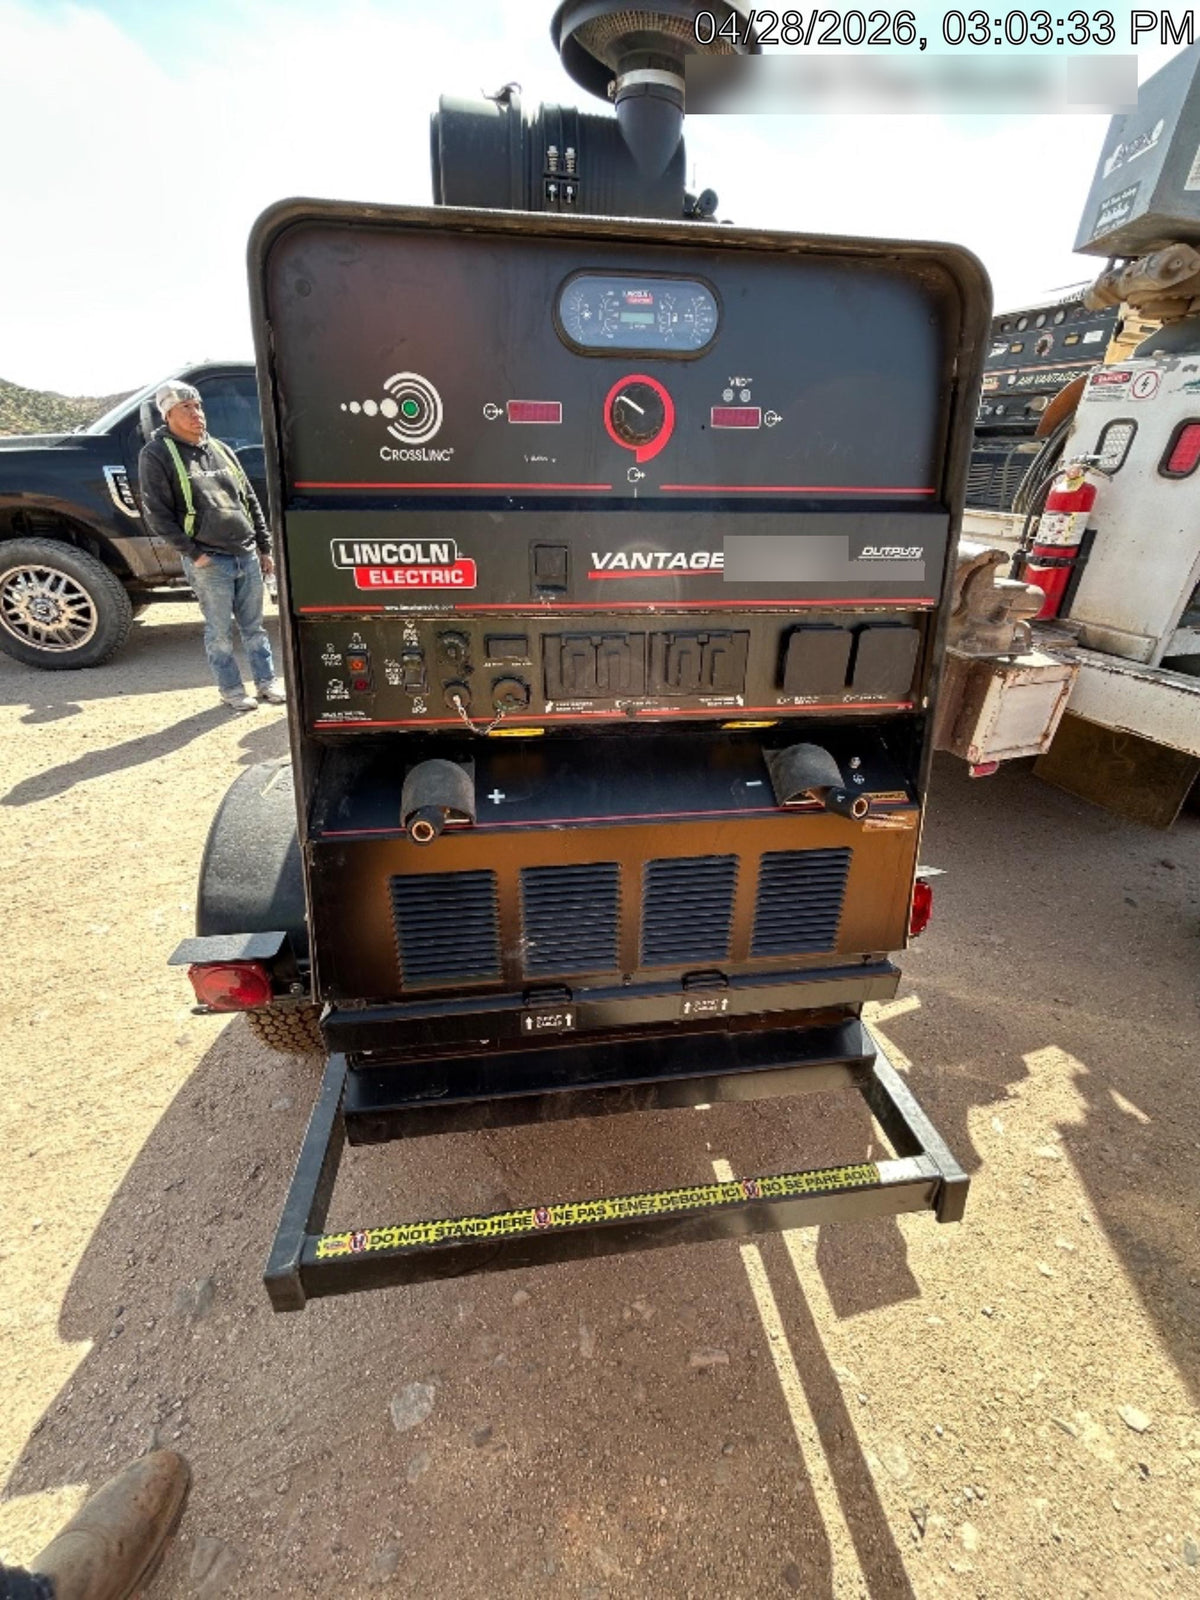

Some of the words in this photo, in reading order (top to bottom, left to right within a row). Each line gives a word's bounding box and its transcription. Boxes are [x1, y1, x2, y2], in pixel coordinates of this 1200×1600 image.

[338, 543, 449, 565] LINCOLN
[591, 552, 725, 570] VANTAGE
[369, 569, 465, 584] ELECTRIC
[761, 1182, 783, 1193] NO
[786, 1180, 804, 1190] SE
[806, 1174, 841, 1187] PARE
[554, 1209, 573, 1220] NE
[577, 1206, 606, 1218] PAS
[611, 1199, 656, 1213] TENEZ
[660, 1190, 719, 1206] DEBOUT
[722, 1188, 740, 1198] ICI
[370, 1234, 395, 1245] DO
[399, 1229, 430, 1241] NOT
[437, 1221, 487, 1236] STAND
[491, 1215, 532, 1229] HERE
